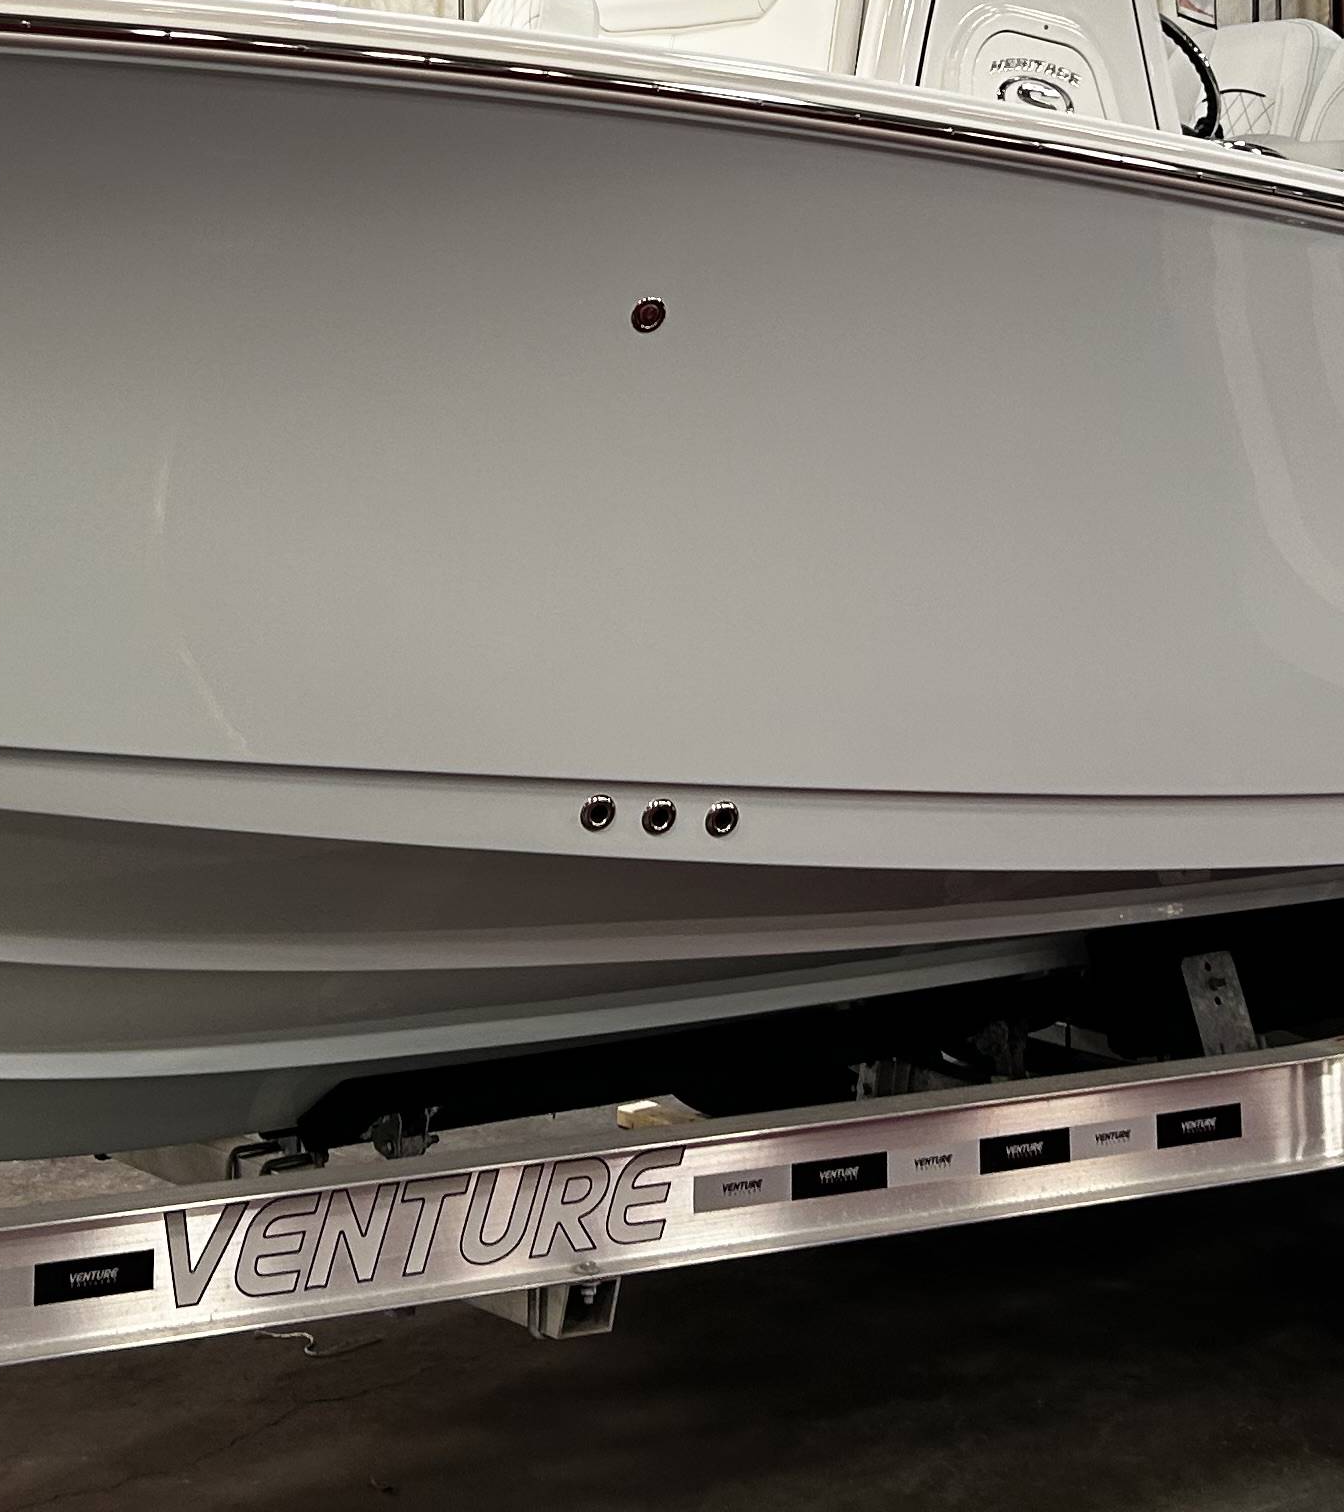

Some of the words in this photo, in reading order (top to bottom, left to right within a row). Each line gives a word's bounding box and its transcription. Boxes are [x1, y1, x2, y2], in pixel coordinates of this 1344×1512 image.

[1095, 1129, 1132, 1143] VENTURE
[1006, 1141, 1044, 1155] VENTURE
[914, 1154, 953, 1168] VENTURE
[818, 1166, 860, 1180] VENTURE
[722, 1179, 763, 1193] VENTURE
[163, 1144, 686, 1309] VENTURE
[69, 1267, 120, 1284] VENTURE
